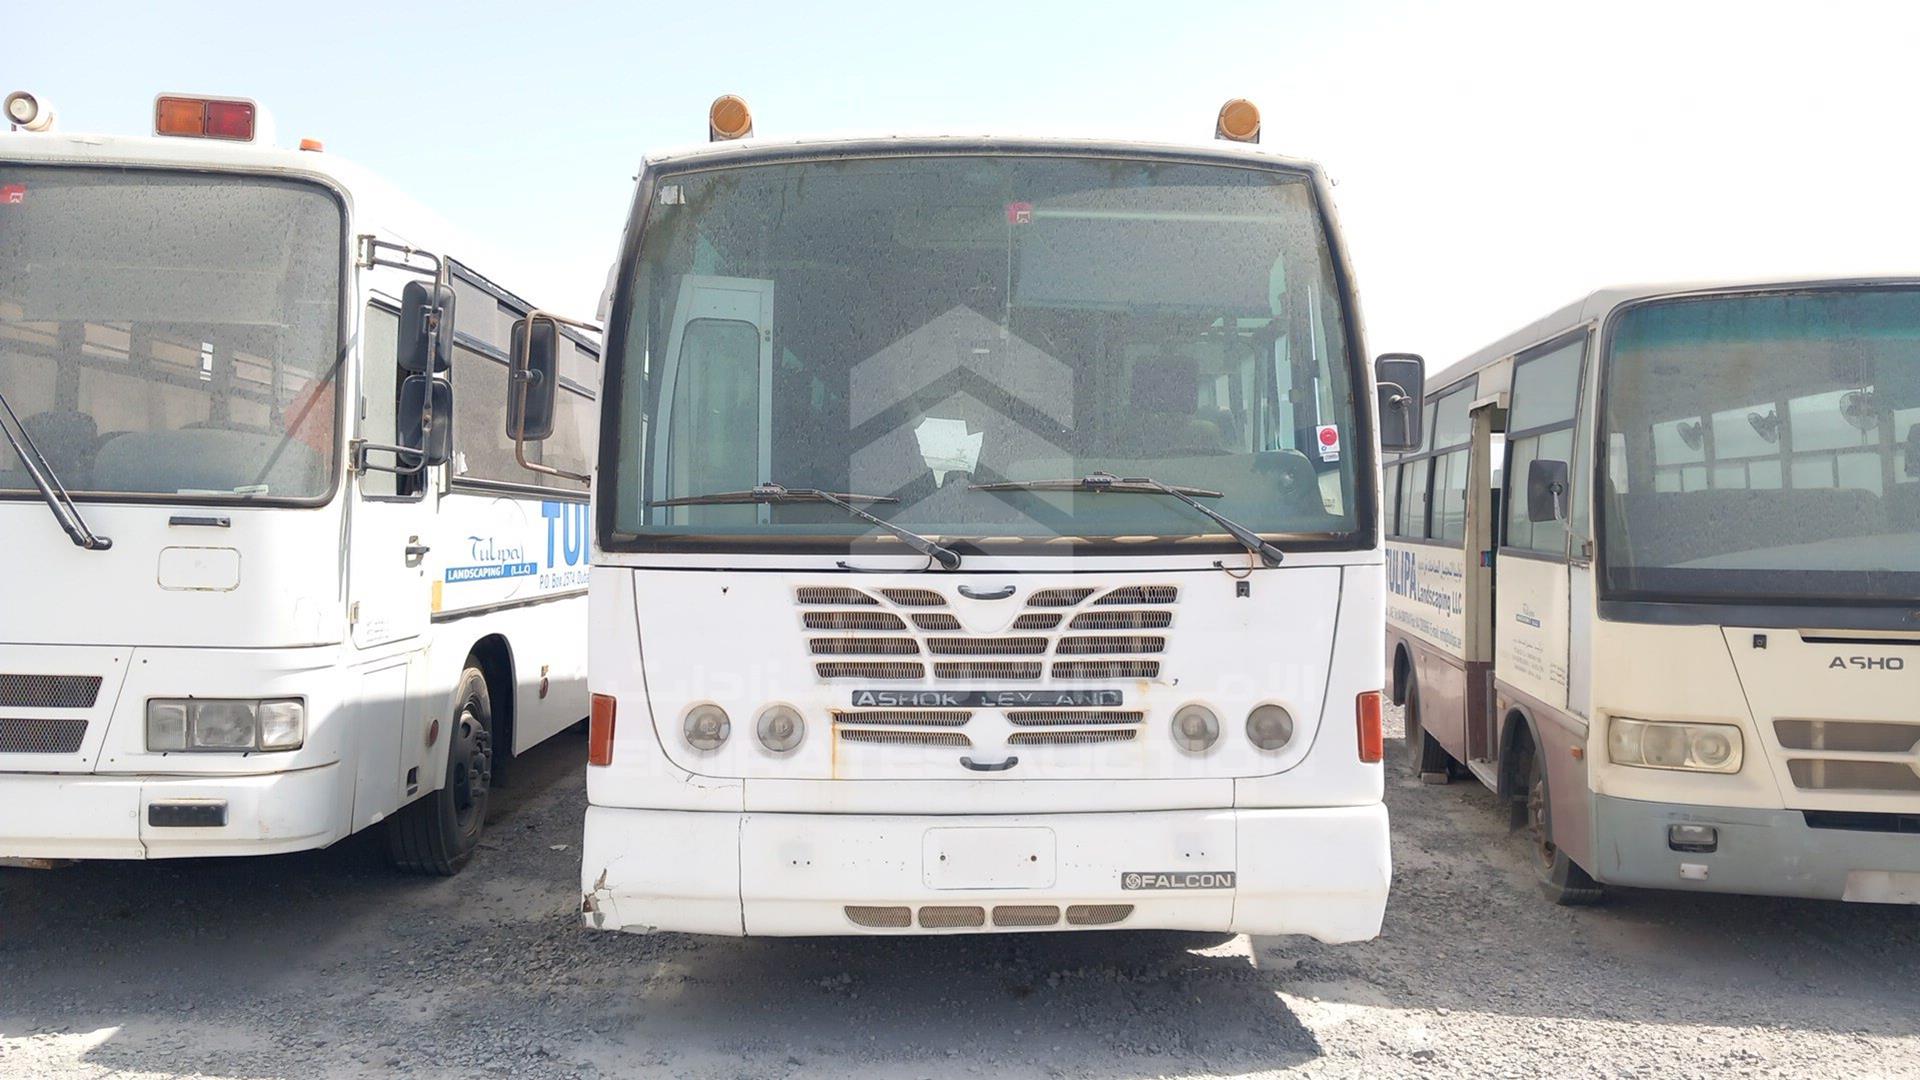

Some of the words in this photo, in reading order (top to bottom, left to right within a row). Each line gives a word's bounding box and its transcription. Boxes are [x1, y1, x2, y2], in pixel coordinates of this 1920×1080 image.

[447, 565, 501, 581] LANDSCAPING
[1418, 581, 1450, 618] Landscaping
[1828, 656, 1904, 670] ASHO
[856, 690, 959, 706] ASHOK
[981, 691, 1120, 707] LEYAND
[1141, 874, 1232, 888] FALCON
